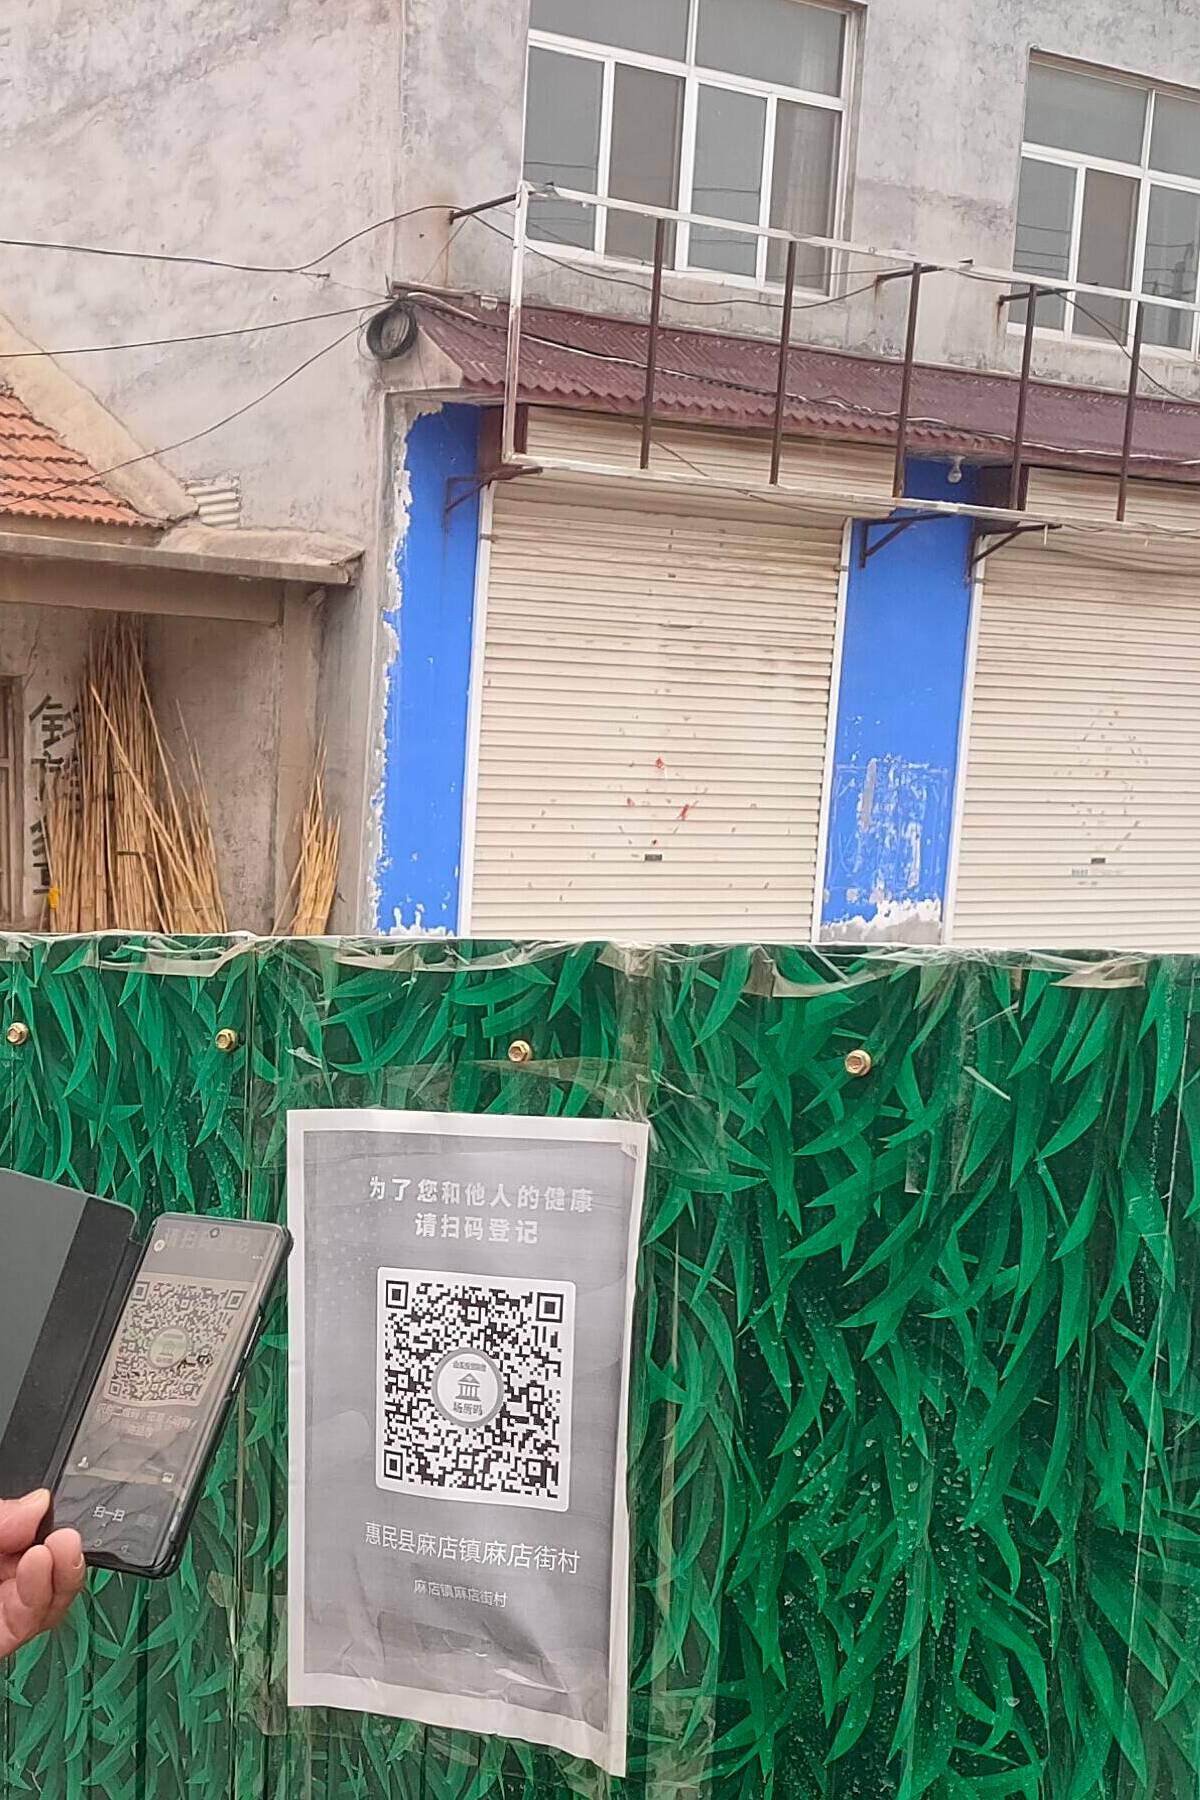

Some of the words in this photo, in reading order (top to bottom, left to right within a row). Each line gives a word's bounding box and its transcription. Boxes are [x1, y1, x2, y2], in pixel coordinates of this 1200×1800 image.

[369, 1175, 593, 1214] 为了您和他人的健康
[414, 1212, 539, 1244] 请扫码登记
[364, 1520, 581, 1574] 惠民县麻店镇麻店街村
[413, 1578, 509, 1608] 麻店镇麻店街村
